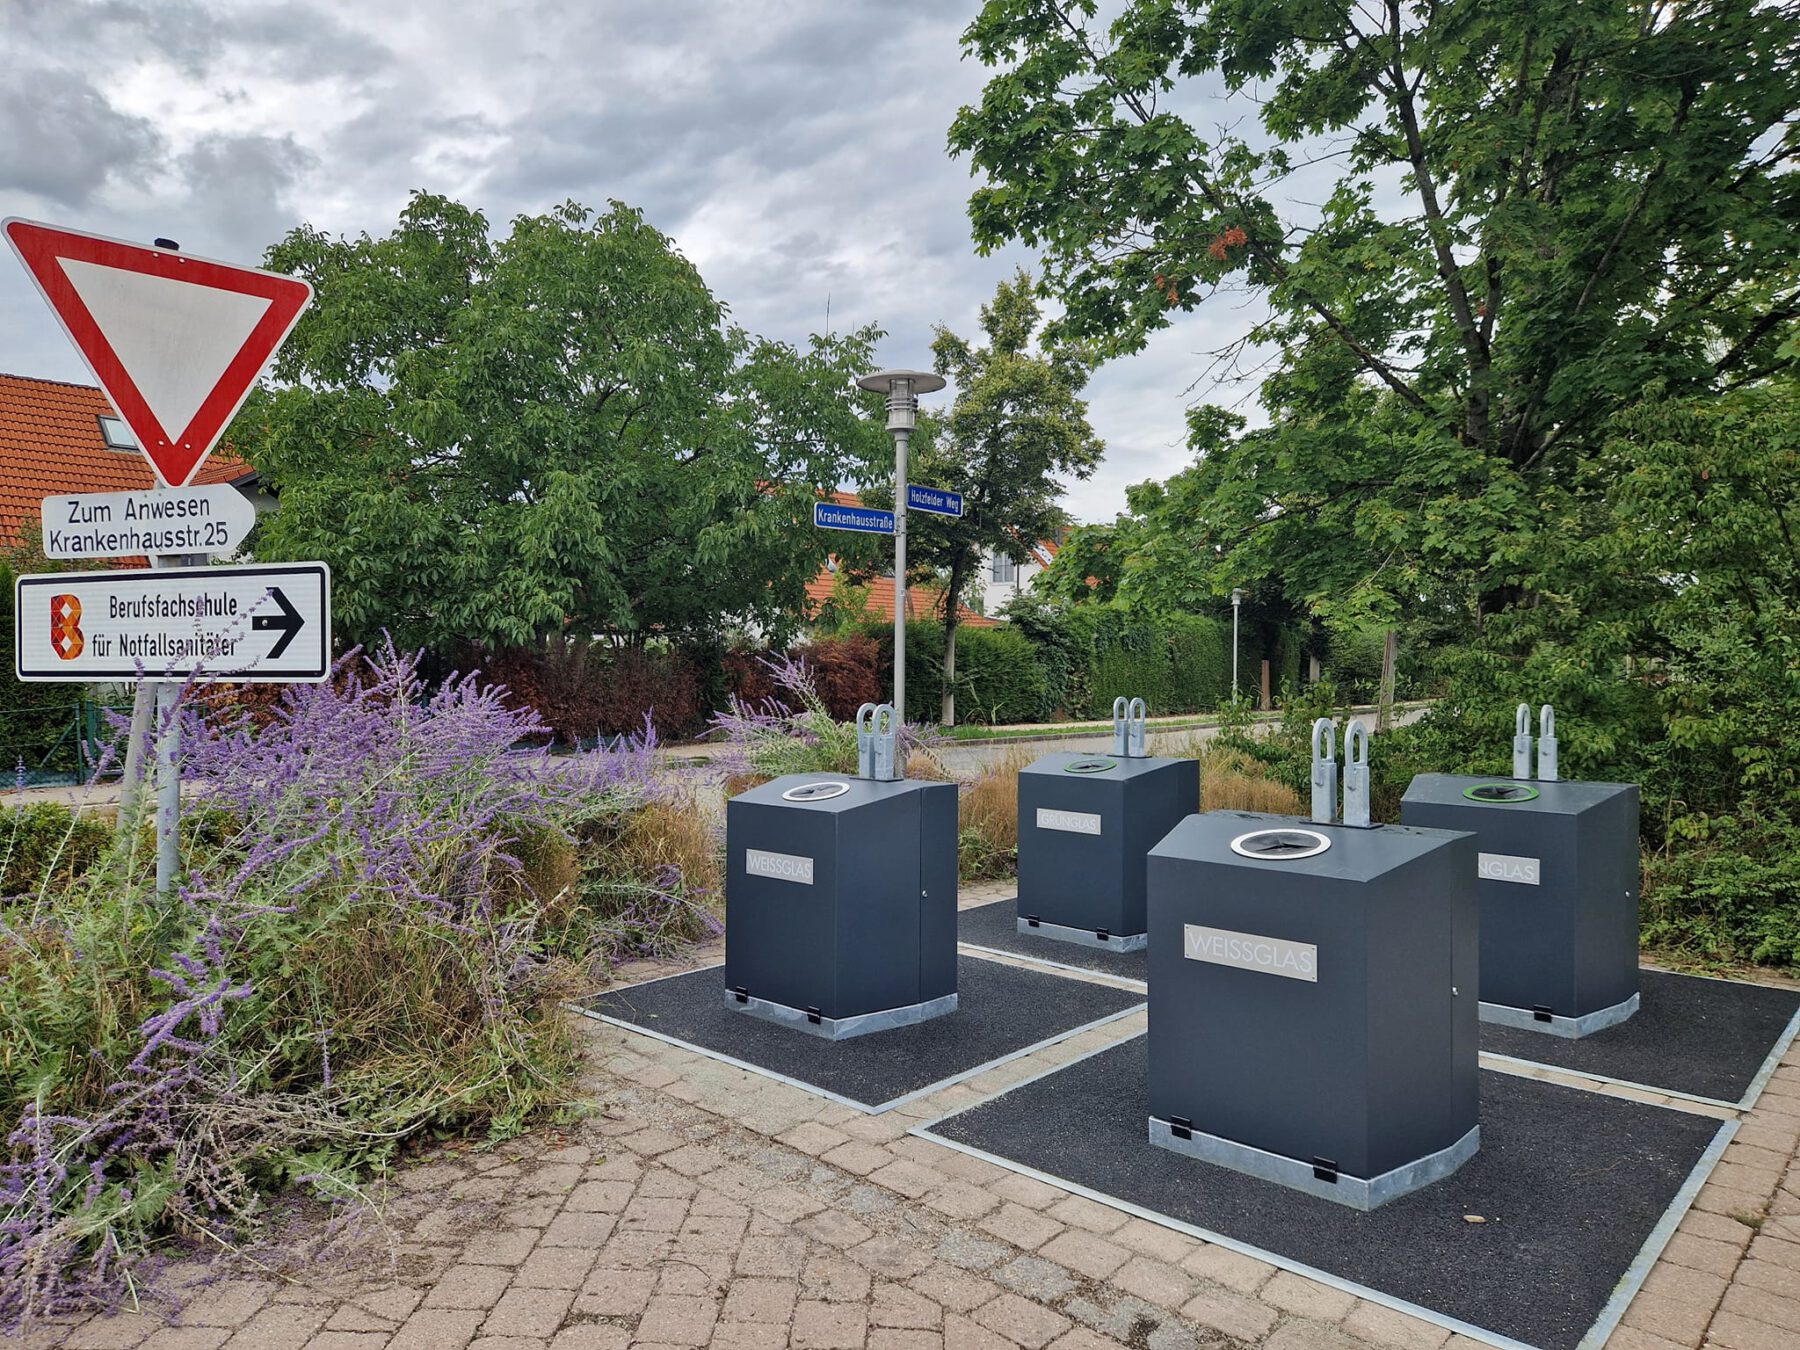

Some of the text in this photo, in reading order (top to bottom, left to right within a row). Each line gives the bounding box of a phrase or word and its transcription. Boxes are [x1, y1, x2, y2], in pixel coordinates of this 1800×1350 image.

[67, 497, 210, 524] Zum Anwesen
[911, 489, 960, 513] Holzfelder Weg
[818, 508, 893, 530] Krankenhausstraße
[92, 632, 112, 657] für
[748, 853, 812, 879] WEISSGLAS
[1478, 860, 1535, 881] NGLAS
[1188, 931, 1313, 974] WEISSGLAS
